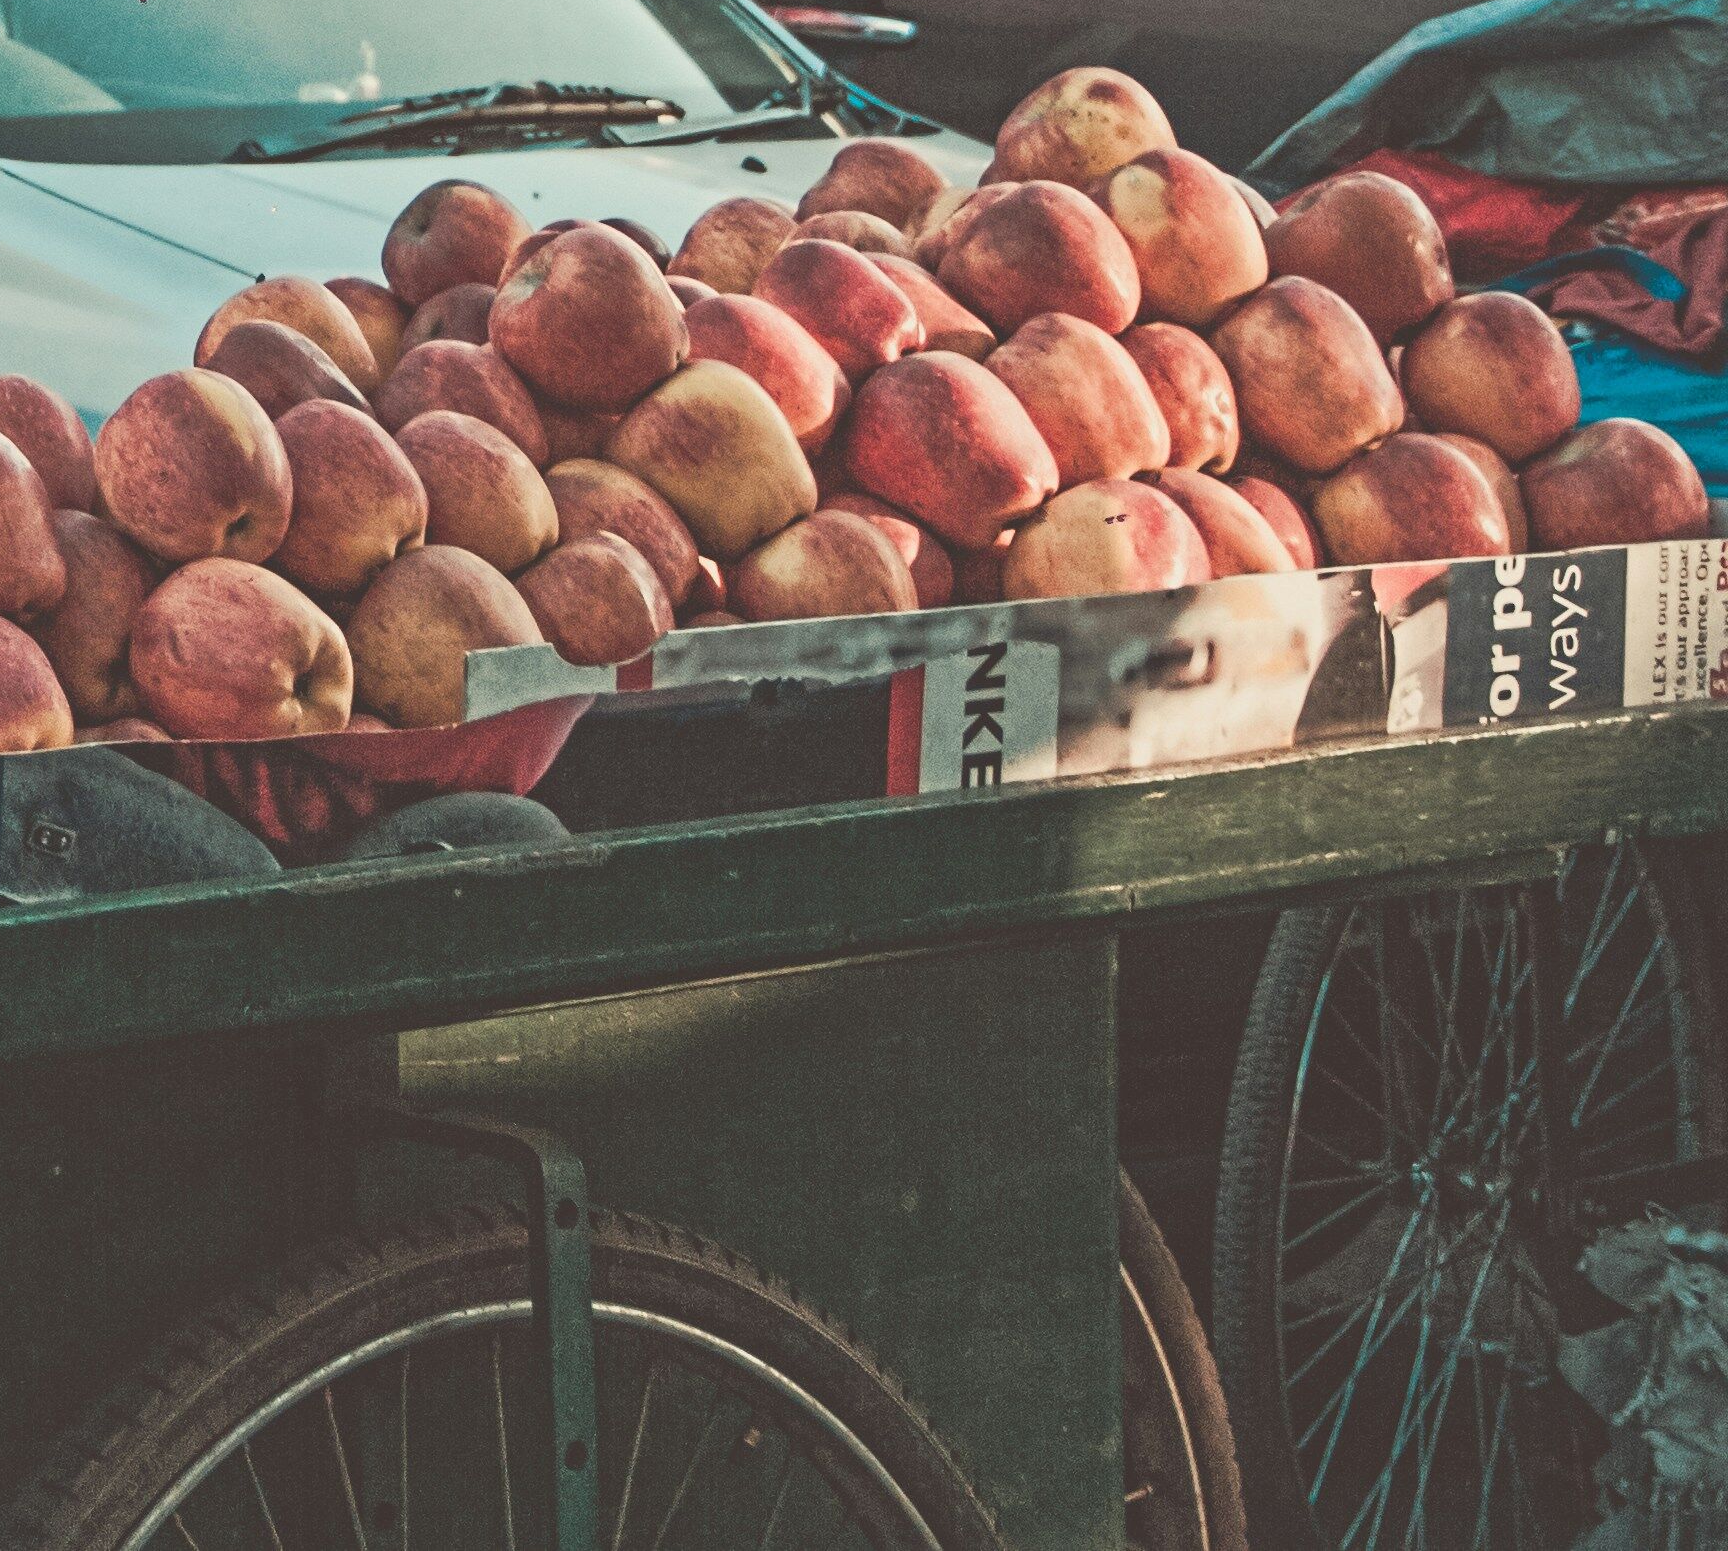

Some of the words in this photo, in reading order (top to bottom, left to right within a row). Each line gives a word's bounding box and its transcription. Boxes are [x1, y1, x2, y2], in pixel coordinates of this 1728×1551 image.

[1549, 564, 1589, 710] ways
[1479, 644, 1521, 725] or
[1653, 656, 1666, 702] LEX
